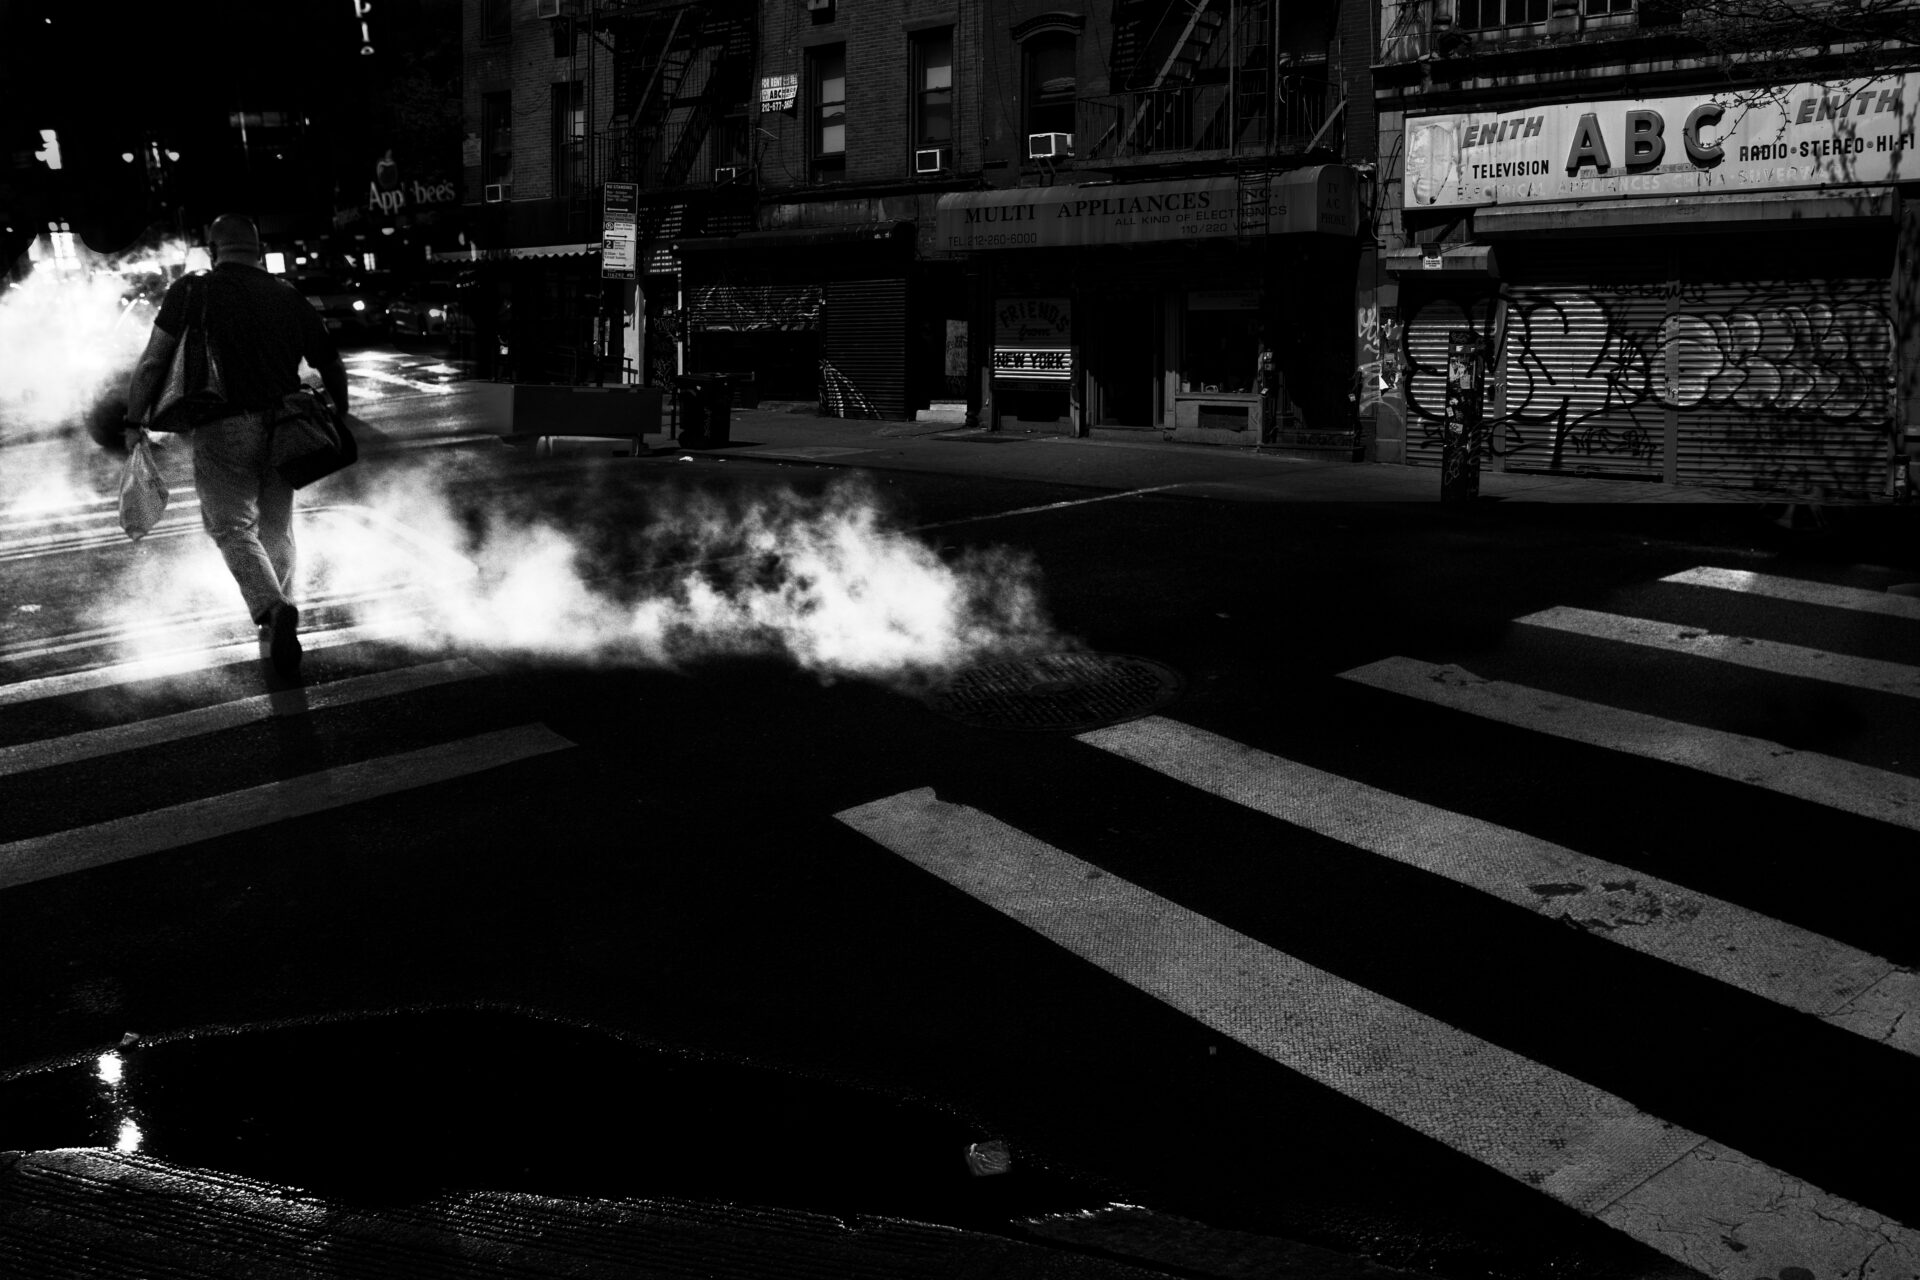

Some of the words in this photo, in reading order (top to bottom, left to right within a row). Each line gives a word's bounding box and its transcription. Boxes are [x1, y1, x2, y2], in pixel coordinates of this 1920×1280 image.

[770, 89, 782, 99] ABC
[1462, 115, 1545, 148] ENITH
[1565, 102, 1726, 177] ABC
[1740, 143, 1787, 162] RADIO
[1799, 137, 1864, 158] STEREO
[1472, 160, 1549, 179] TELEVISION
[1327, 182, 1339, 193] TV
[965, 204, 1036, 224] MULTI
[1057, 191, 1210, 218] APPLIANCES
[1114, 216, 1136, 226] ALL
[1142, 215, 1170, 224] KIND
[1176, 213, 1190, 222] OF
[1181, 222, 1228, 234] 110/220
[1000, 301, 1069, 333] FRIENDS
[996, 352, 1023, 369] NEW
[1030, 352, 1063, 369] YORK
